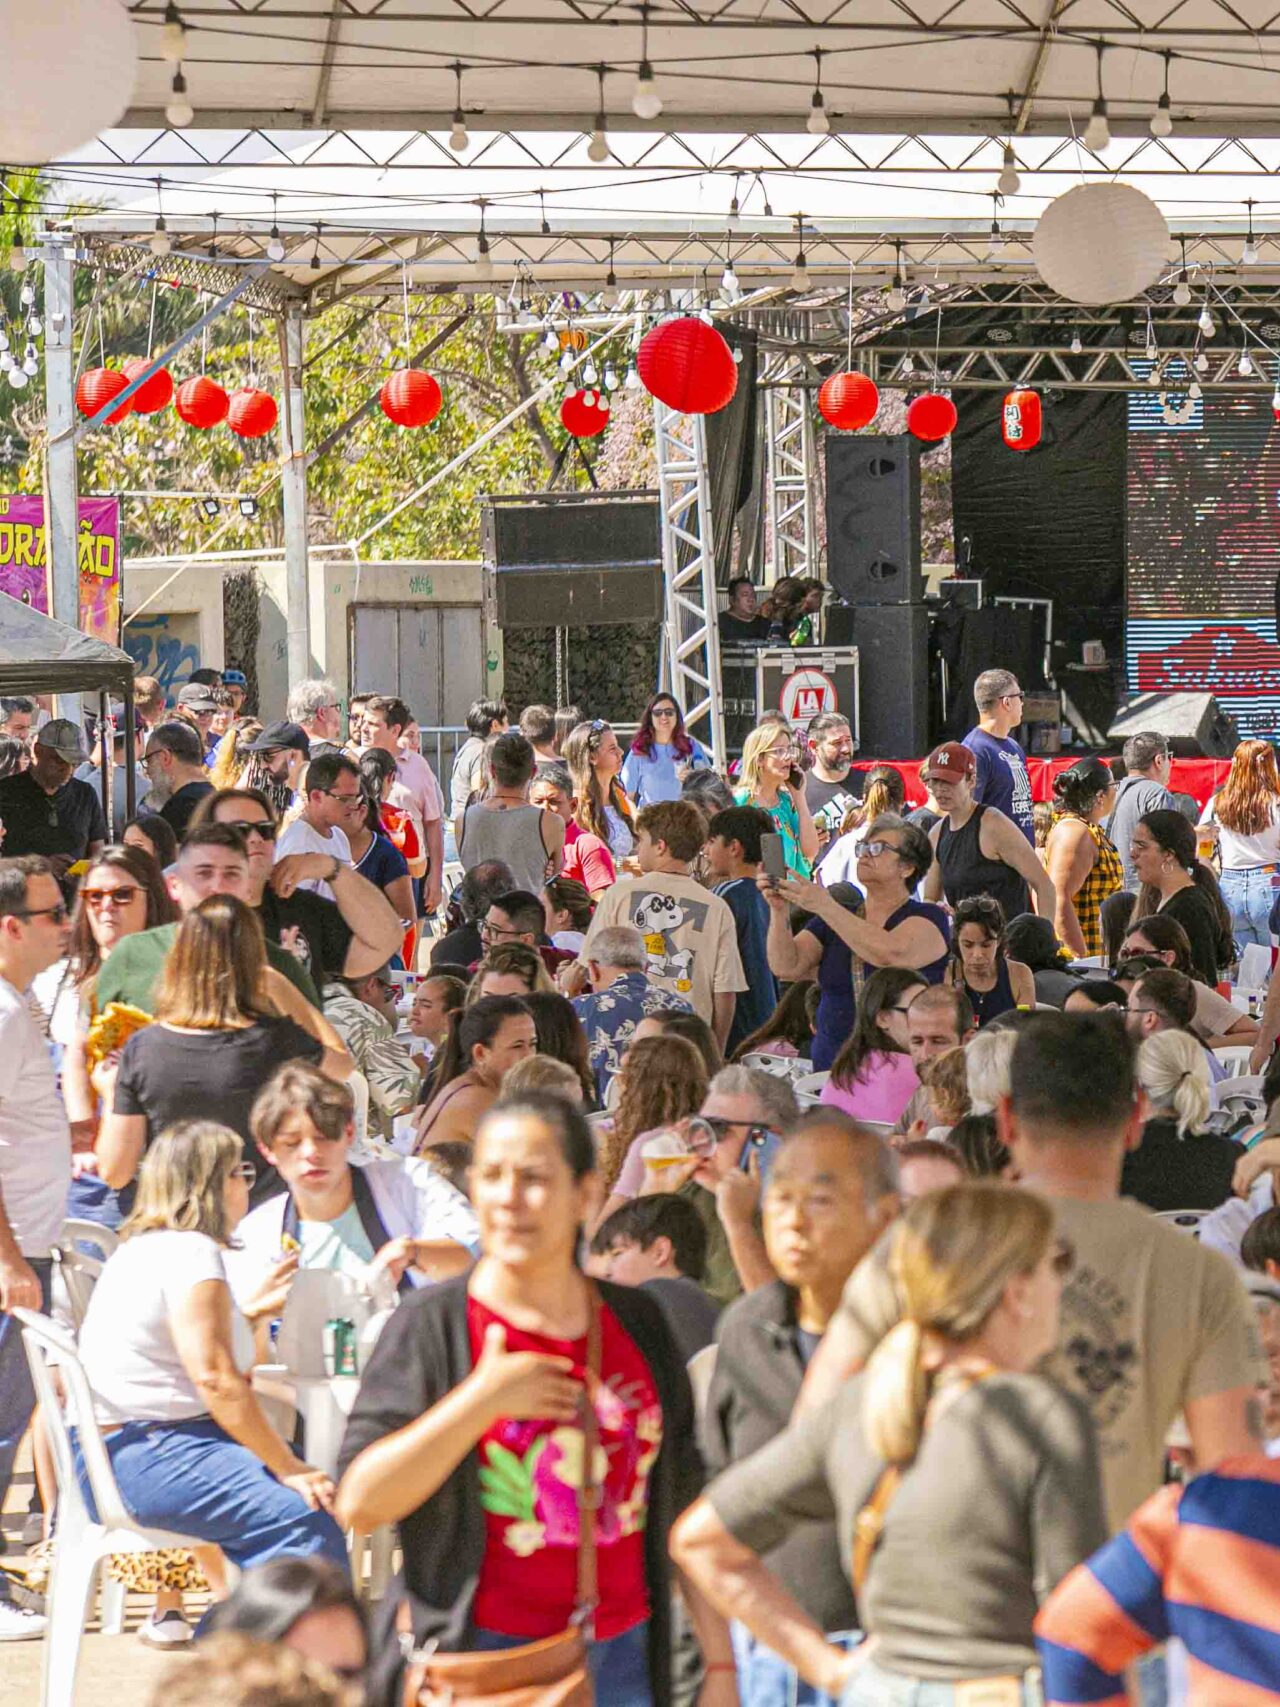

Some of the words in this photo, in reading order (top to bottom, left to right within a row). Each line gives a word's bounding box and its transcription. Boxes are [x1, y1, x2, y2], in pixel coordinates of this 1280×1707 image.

[0, 518, 115, 577] DRAÃO
[798, 690, 820, 710] LA
[936, 751, 949, 765] NY
